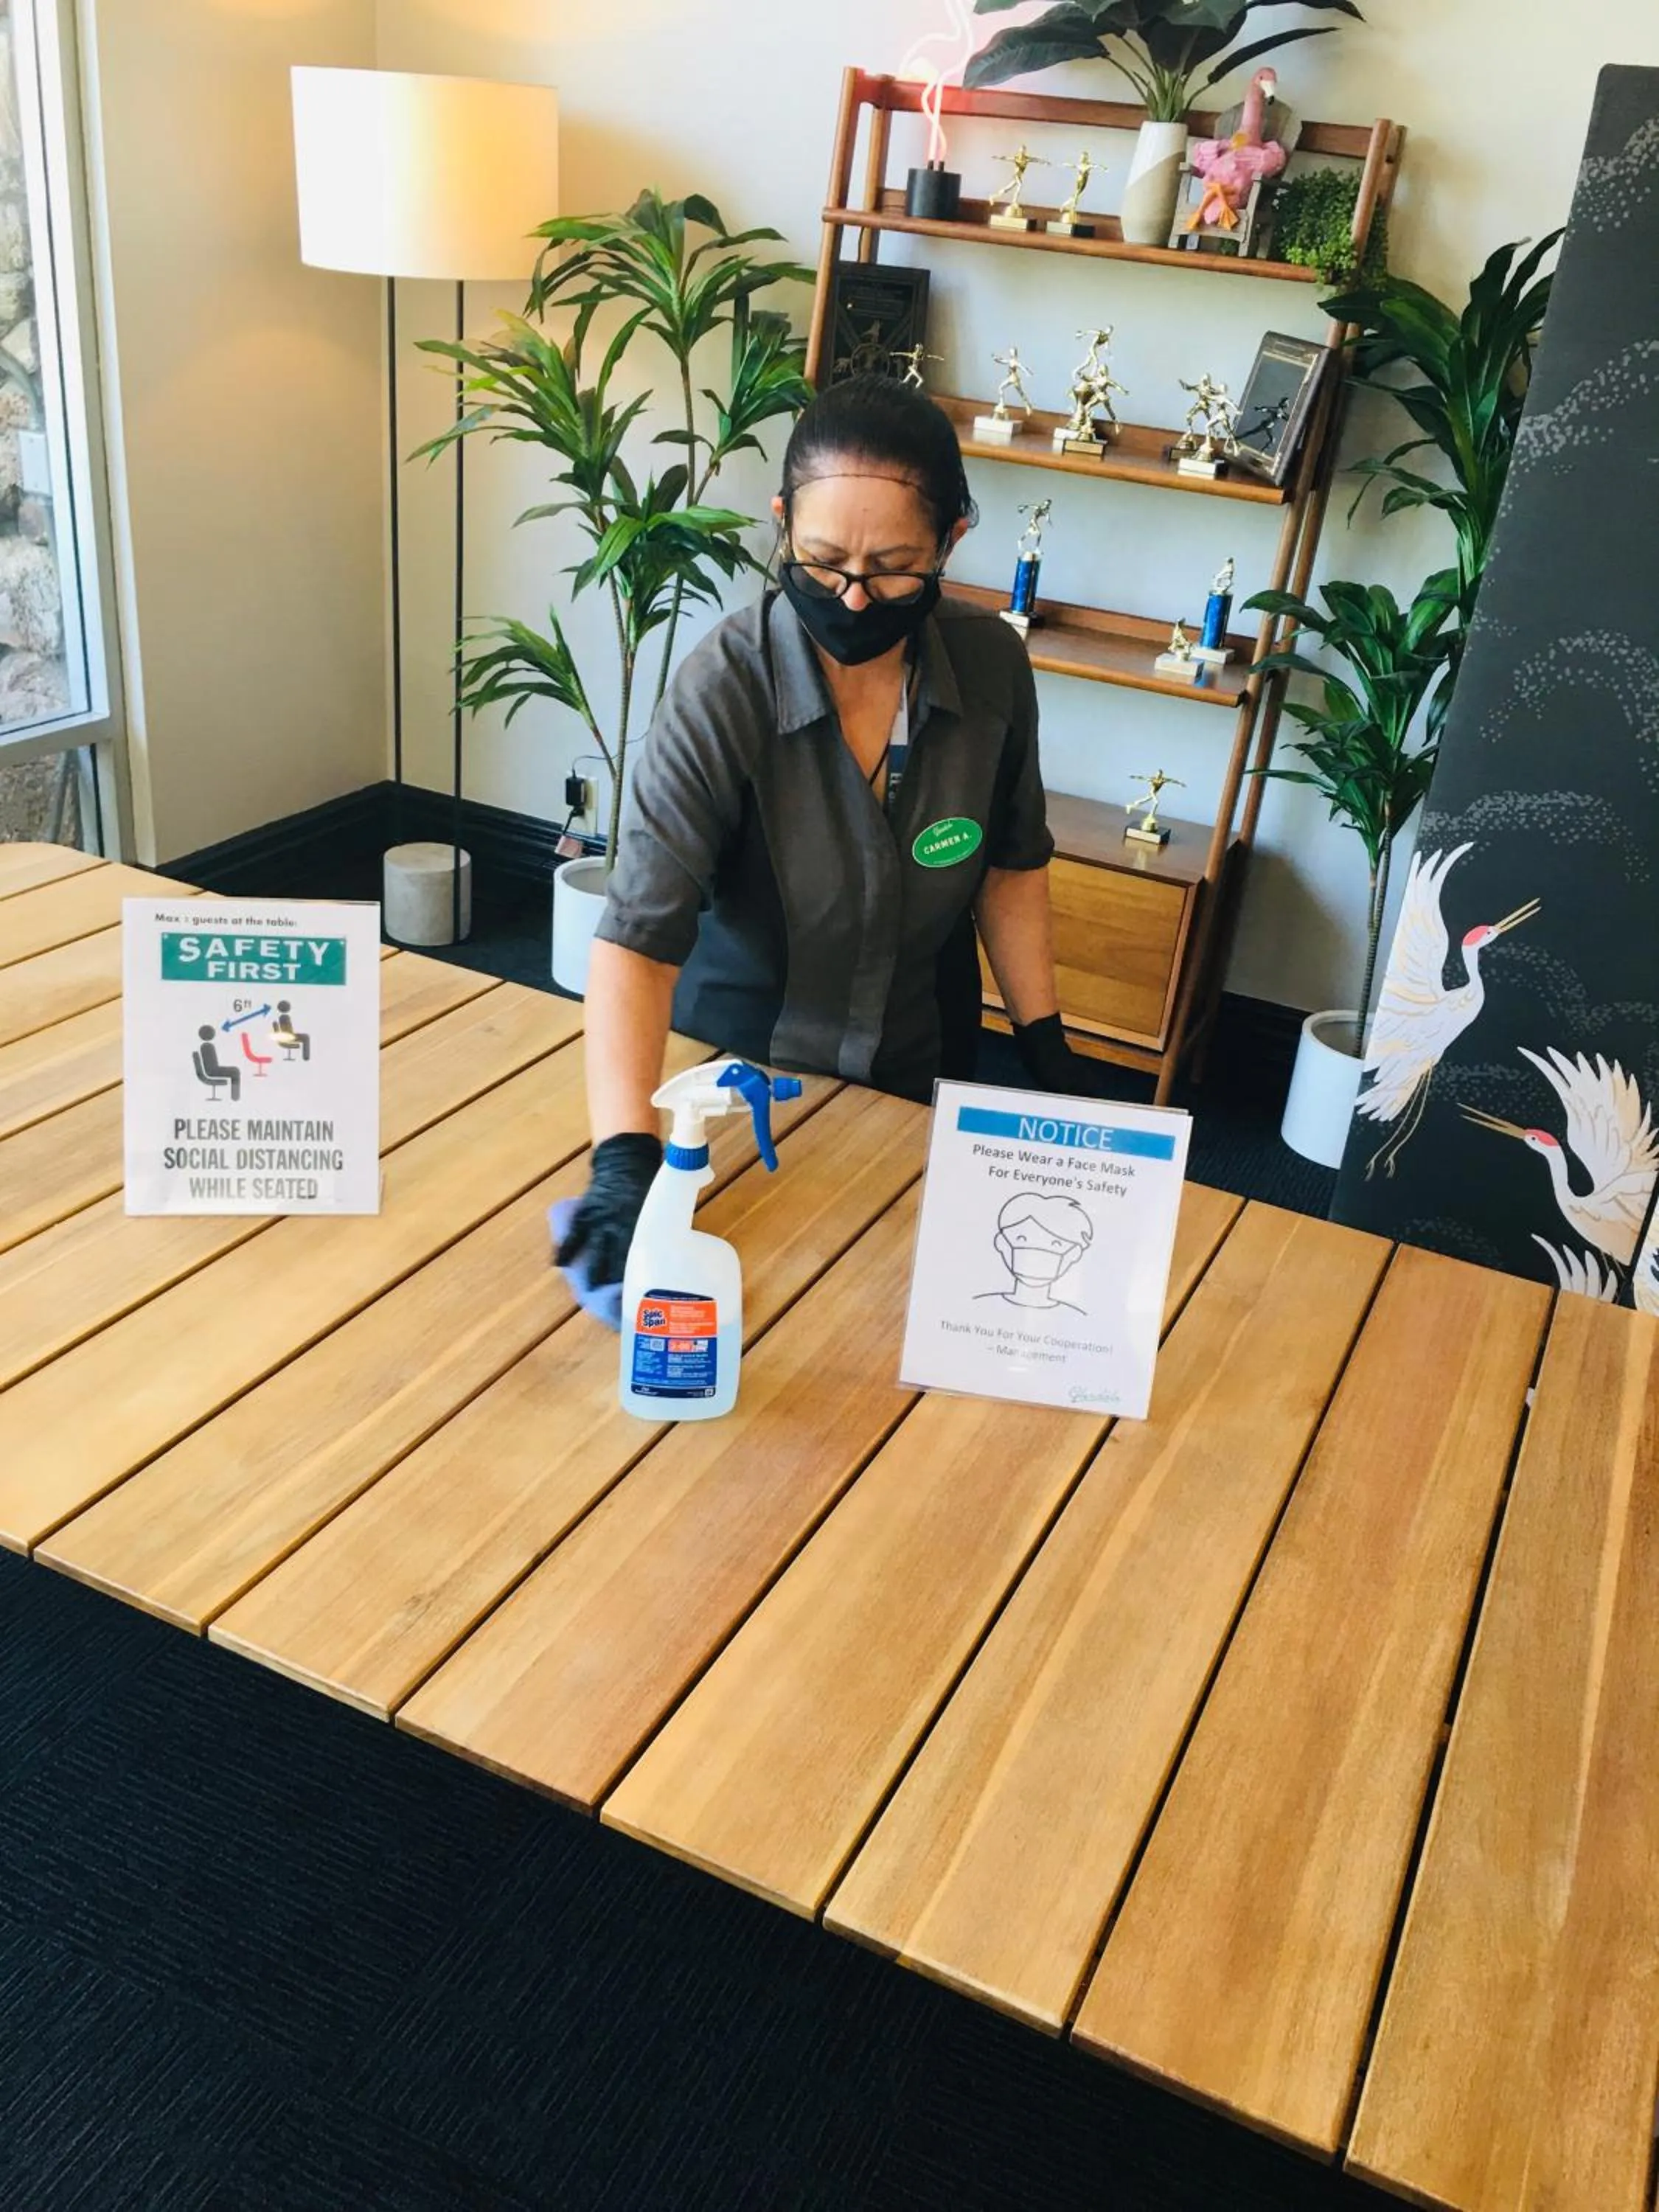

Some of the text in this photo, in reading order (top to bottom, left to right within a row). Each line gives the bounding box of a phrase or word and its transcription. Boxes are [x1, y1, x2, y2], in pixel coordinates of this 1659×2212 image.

[924, 835, 961, 855] CARMEN
[155, 914, 179, 922] Max
[192, 916, 228, 925] guests
[232, 917, 243, 925] at
[246, 916, 263, 925] the
[178, 937, 330, 966] SAFETY
[207, 961, 301, 980] FIRST
[174, 1119, 334, 1141] PLEASE MAINTAIN
[1018, 1117, 1114, 1151] NOTICE
[164, 1147, 344, 1171] SOCIAL DISTANCING
[973, 1144, 1136, 1178] Please Wear a Face Mask
[189, 1178, 319, 1200] WHILE SEATED
[988, 1166, 1128, 1198] For Everyone's Safety
[642, 1318, 666, 1328] Span
[941, 1321, 971, 1335] Thank
[974, 1326, 995, 1338] You
[997, 1328, 1015, 1340] For
[1018, 1332, 1042, 1344] Your
